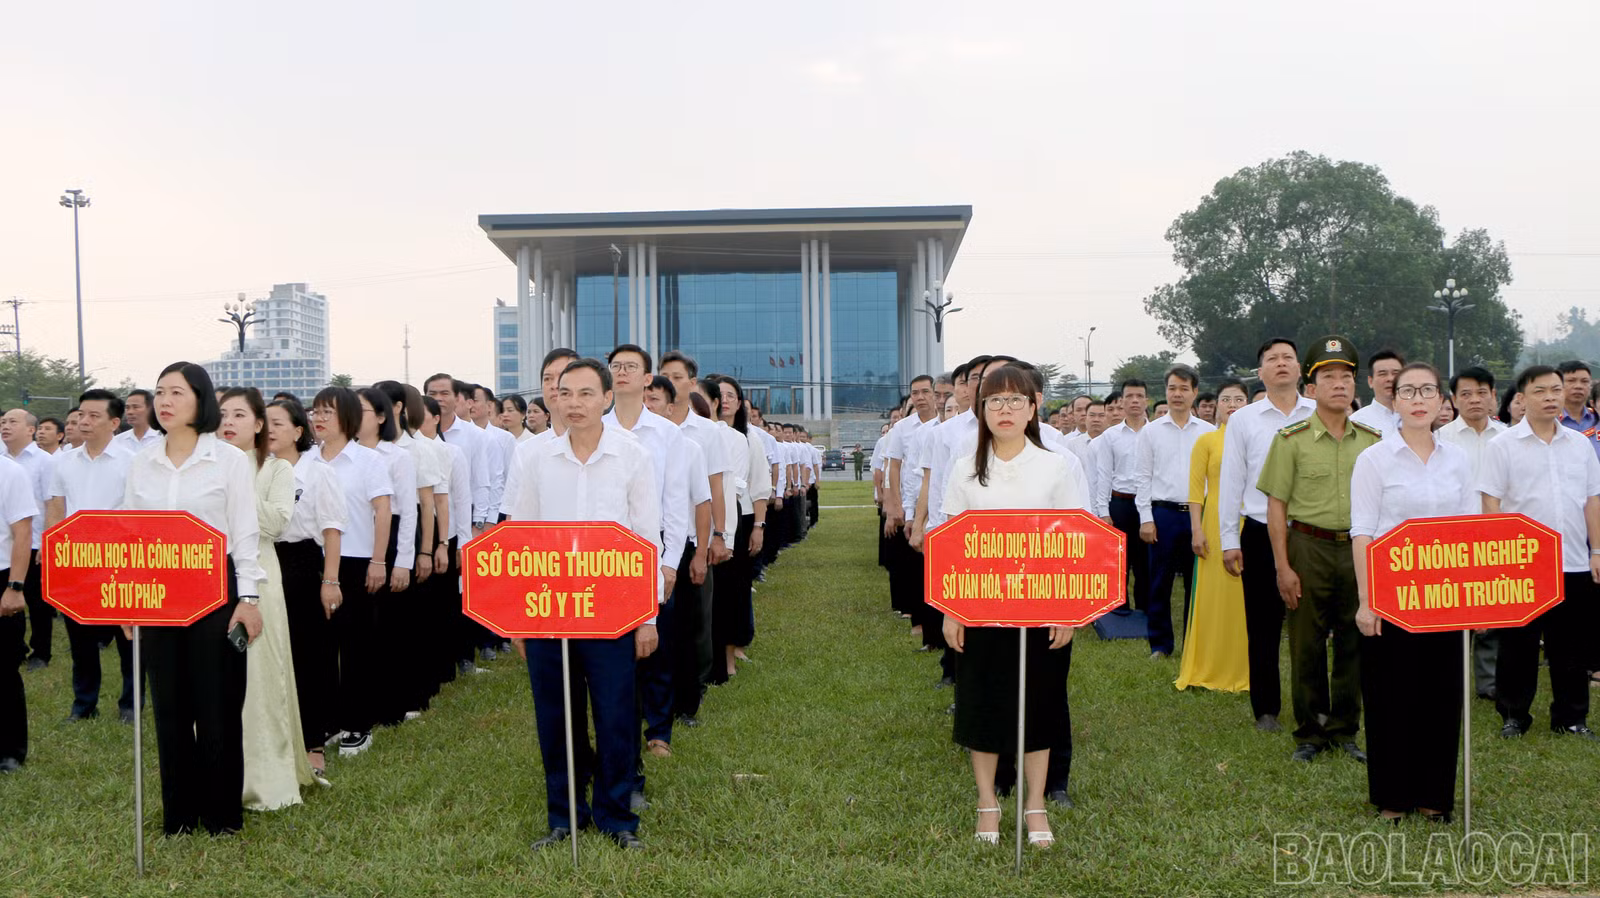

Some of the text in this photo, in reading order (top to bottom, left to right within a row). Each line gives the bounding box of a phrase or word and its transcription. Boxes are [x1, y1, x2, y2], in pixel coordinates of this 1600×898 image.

[55, 534, 213, 575] SỞ KHOA HỌC VÀ CÔNG NGHỆ
[476, 542, 644, 577] SỞ CÔNG THƯƠNG
[964, 524, 1085, 564] SỞ GIÁO DỤC VÀ ĐÀO TẠO
[1389, 533, 1539, 572] SỞ NÔNG NGHIỆP
[101, 575, 166, 608] SỞ TƯ PHÁP
[525, 584, 596, 618] SỞ Y TẾ
[942, 564, 1108, 605] SỞ VĂN HÓA, THỂ THAO VÀ DU LỊCH
[1396, 574, 1535, 610] VÀ MÔI TRƯỜNG
